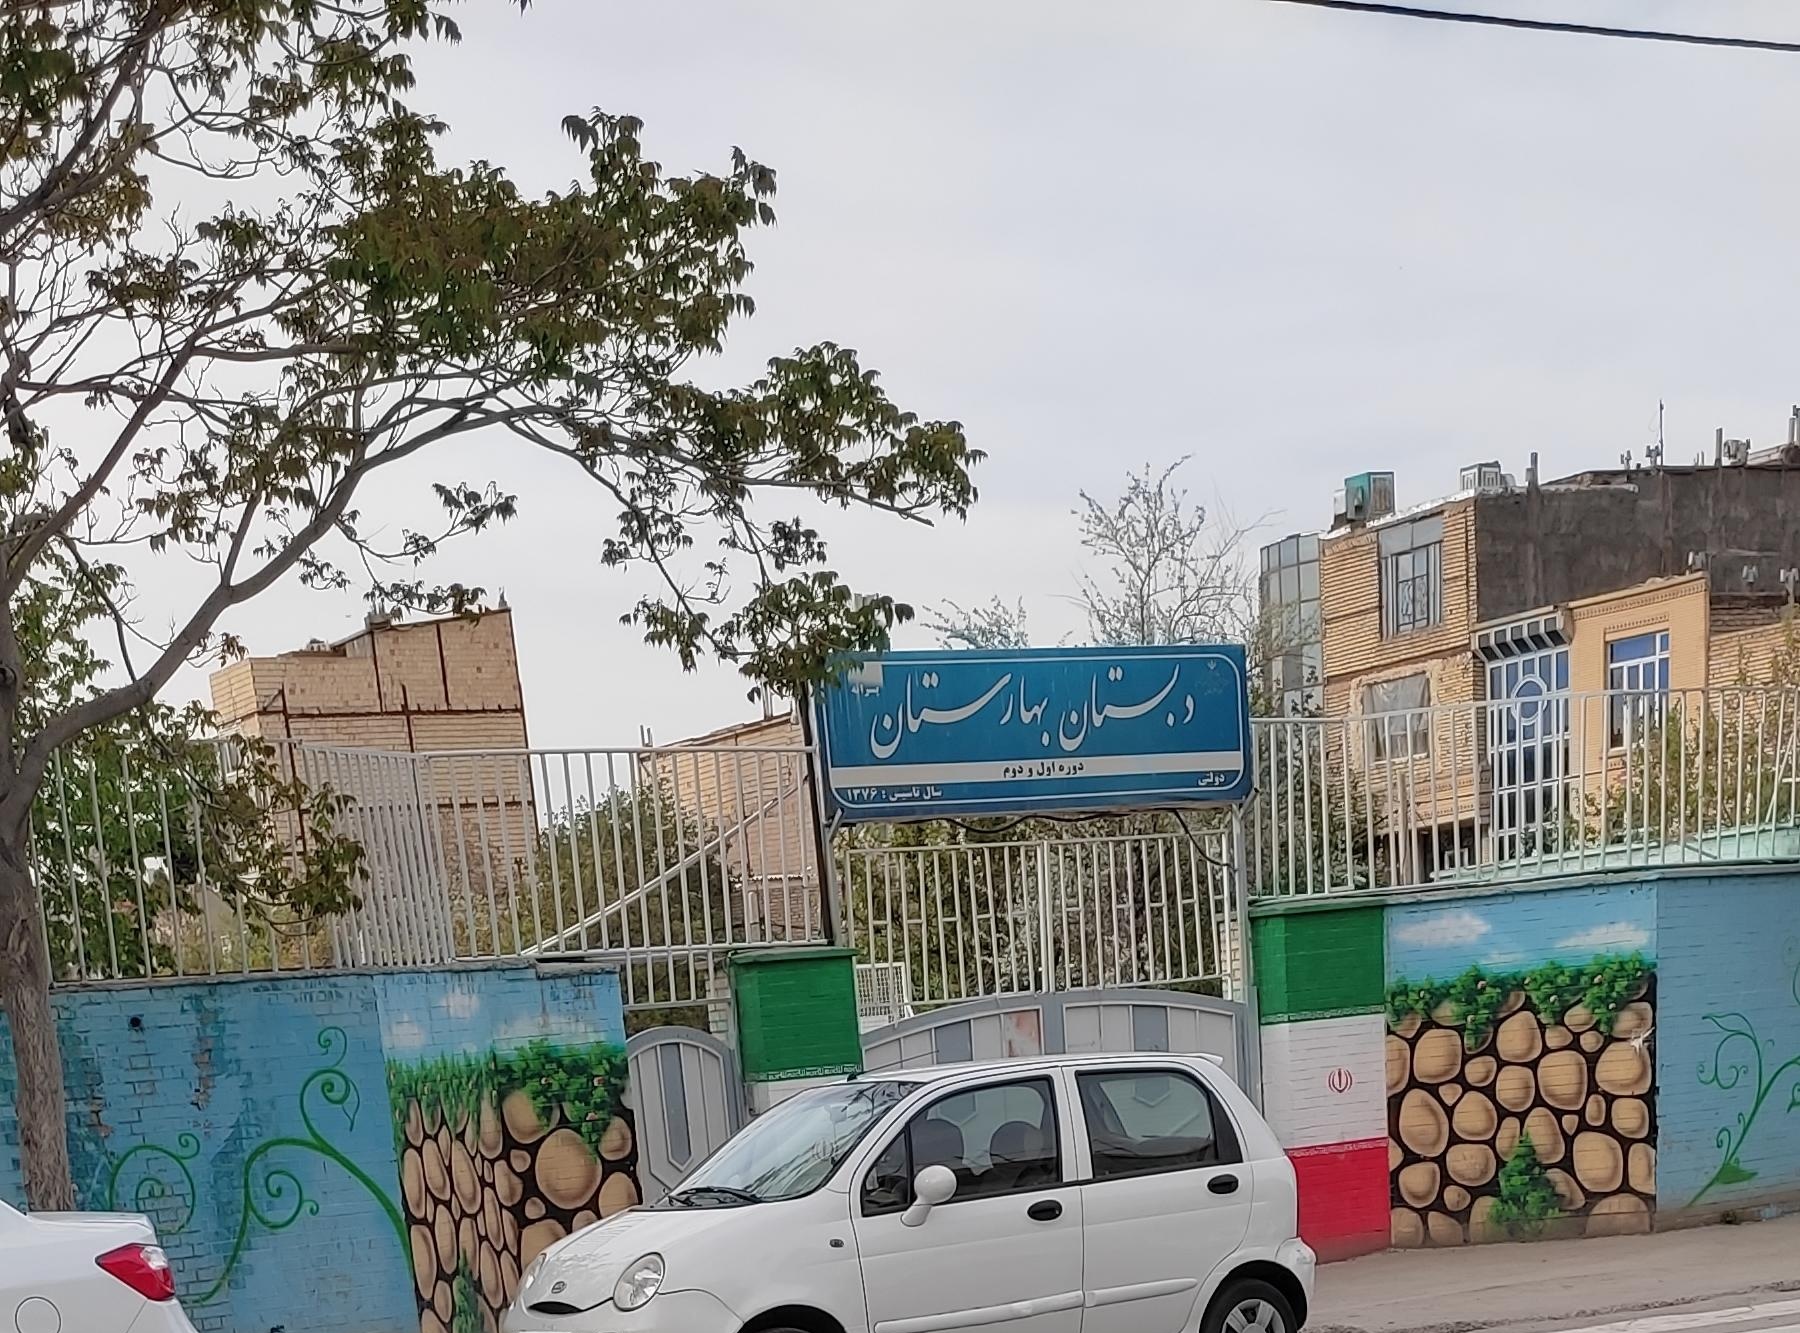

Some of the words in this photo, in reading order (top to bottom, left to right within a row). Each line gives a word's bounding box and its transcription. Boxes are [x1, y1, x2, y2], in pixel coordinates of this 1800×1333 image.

[1058, 663, 1195, 752] دبستان
[869, 671, 1050, 760] بهارستان
[1003, 765, 1024, 779] دوم
[1027, 767, 1034, 778] و
[1036, 761, 1056, 777] اول
[1058, 762, 1084, 776] دوره
[1197, 771, 1226, 787] دولتی
[847, 787, 878, 801] ۱۳۷۶
[922, 785, 943, 800] سال
